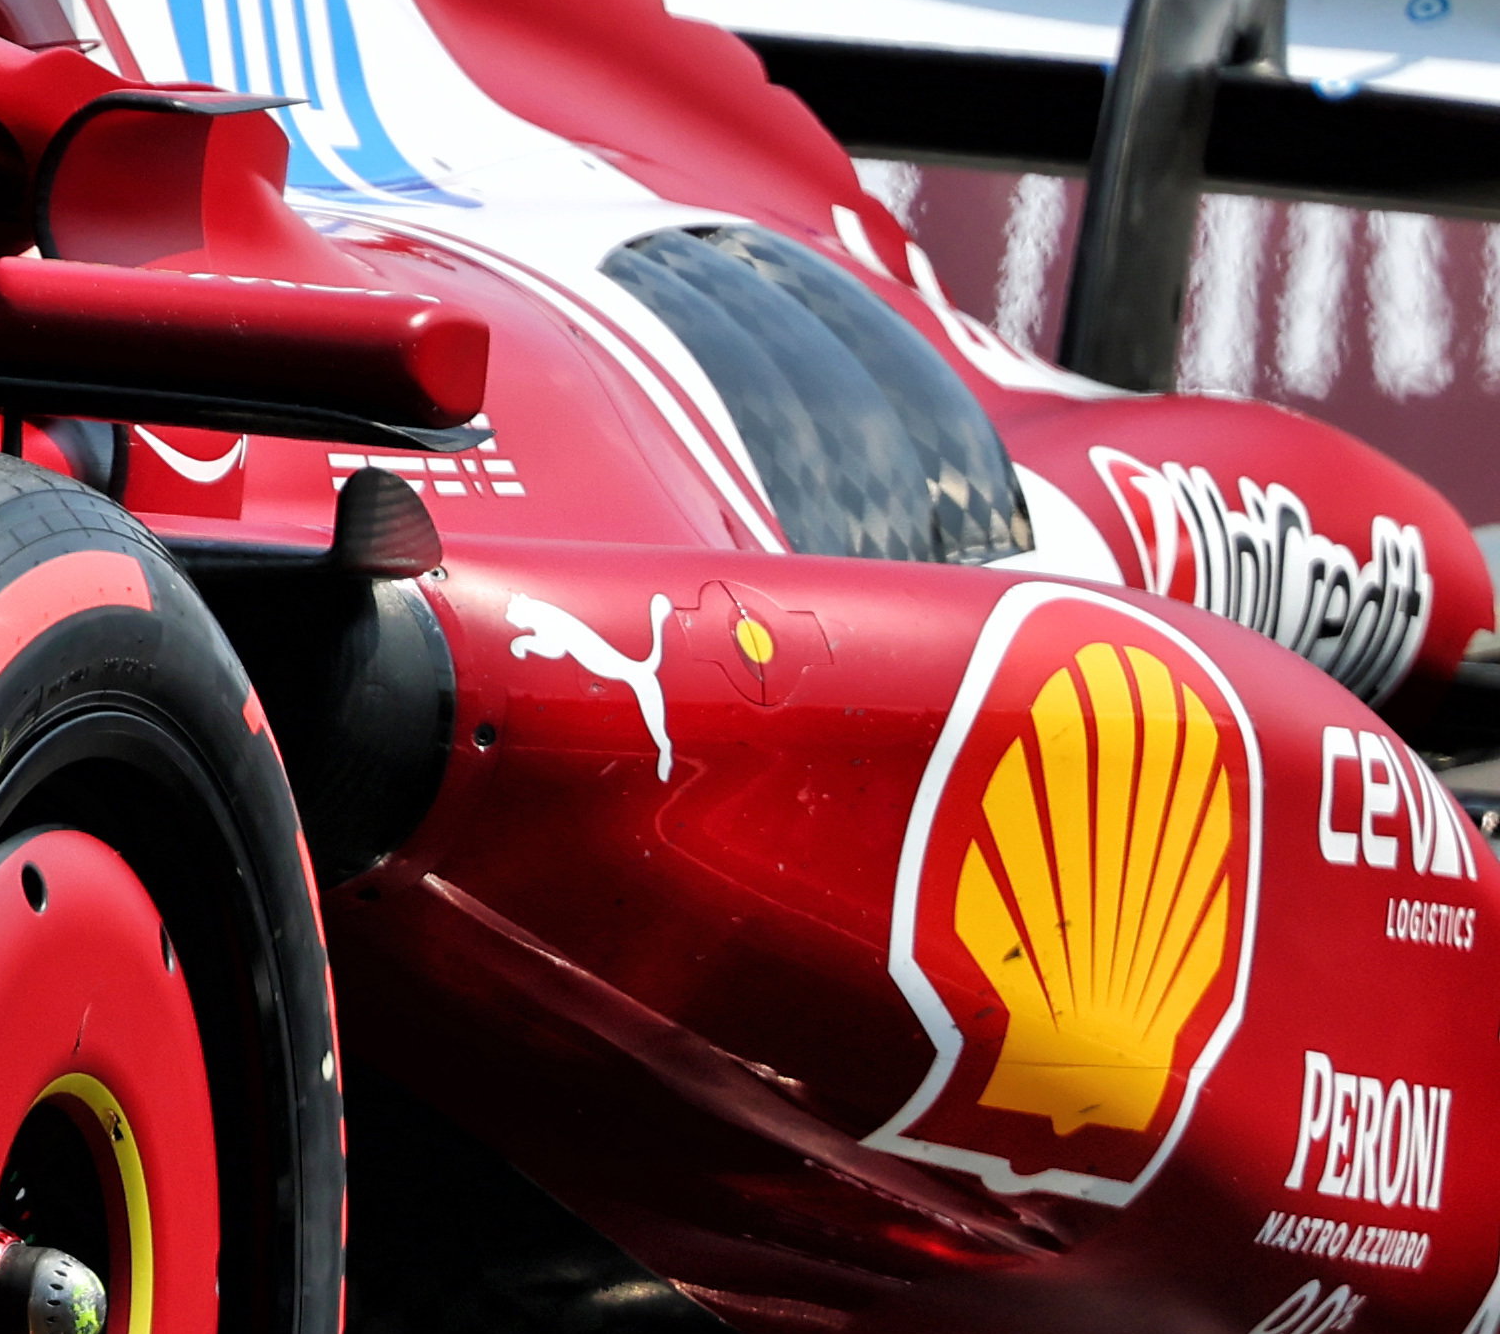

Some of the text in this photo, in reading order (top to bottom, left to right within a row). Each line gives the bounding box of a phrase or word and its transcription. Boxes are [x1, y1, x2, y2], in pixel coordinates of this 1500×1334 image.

[1386, 898, 1477, 952] LOGISTICS
[1284, 1050, 1452, 1210] PERONI
[1255, 1210, 1431, 1269] NASTRO AZZURRO
